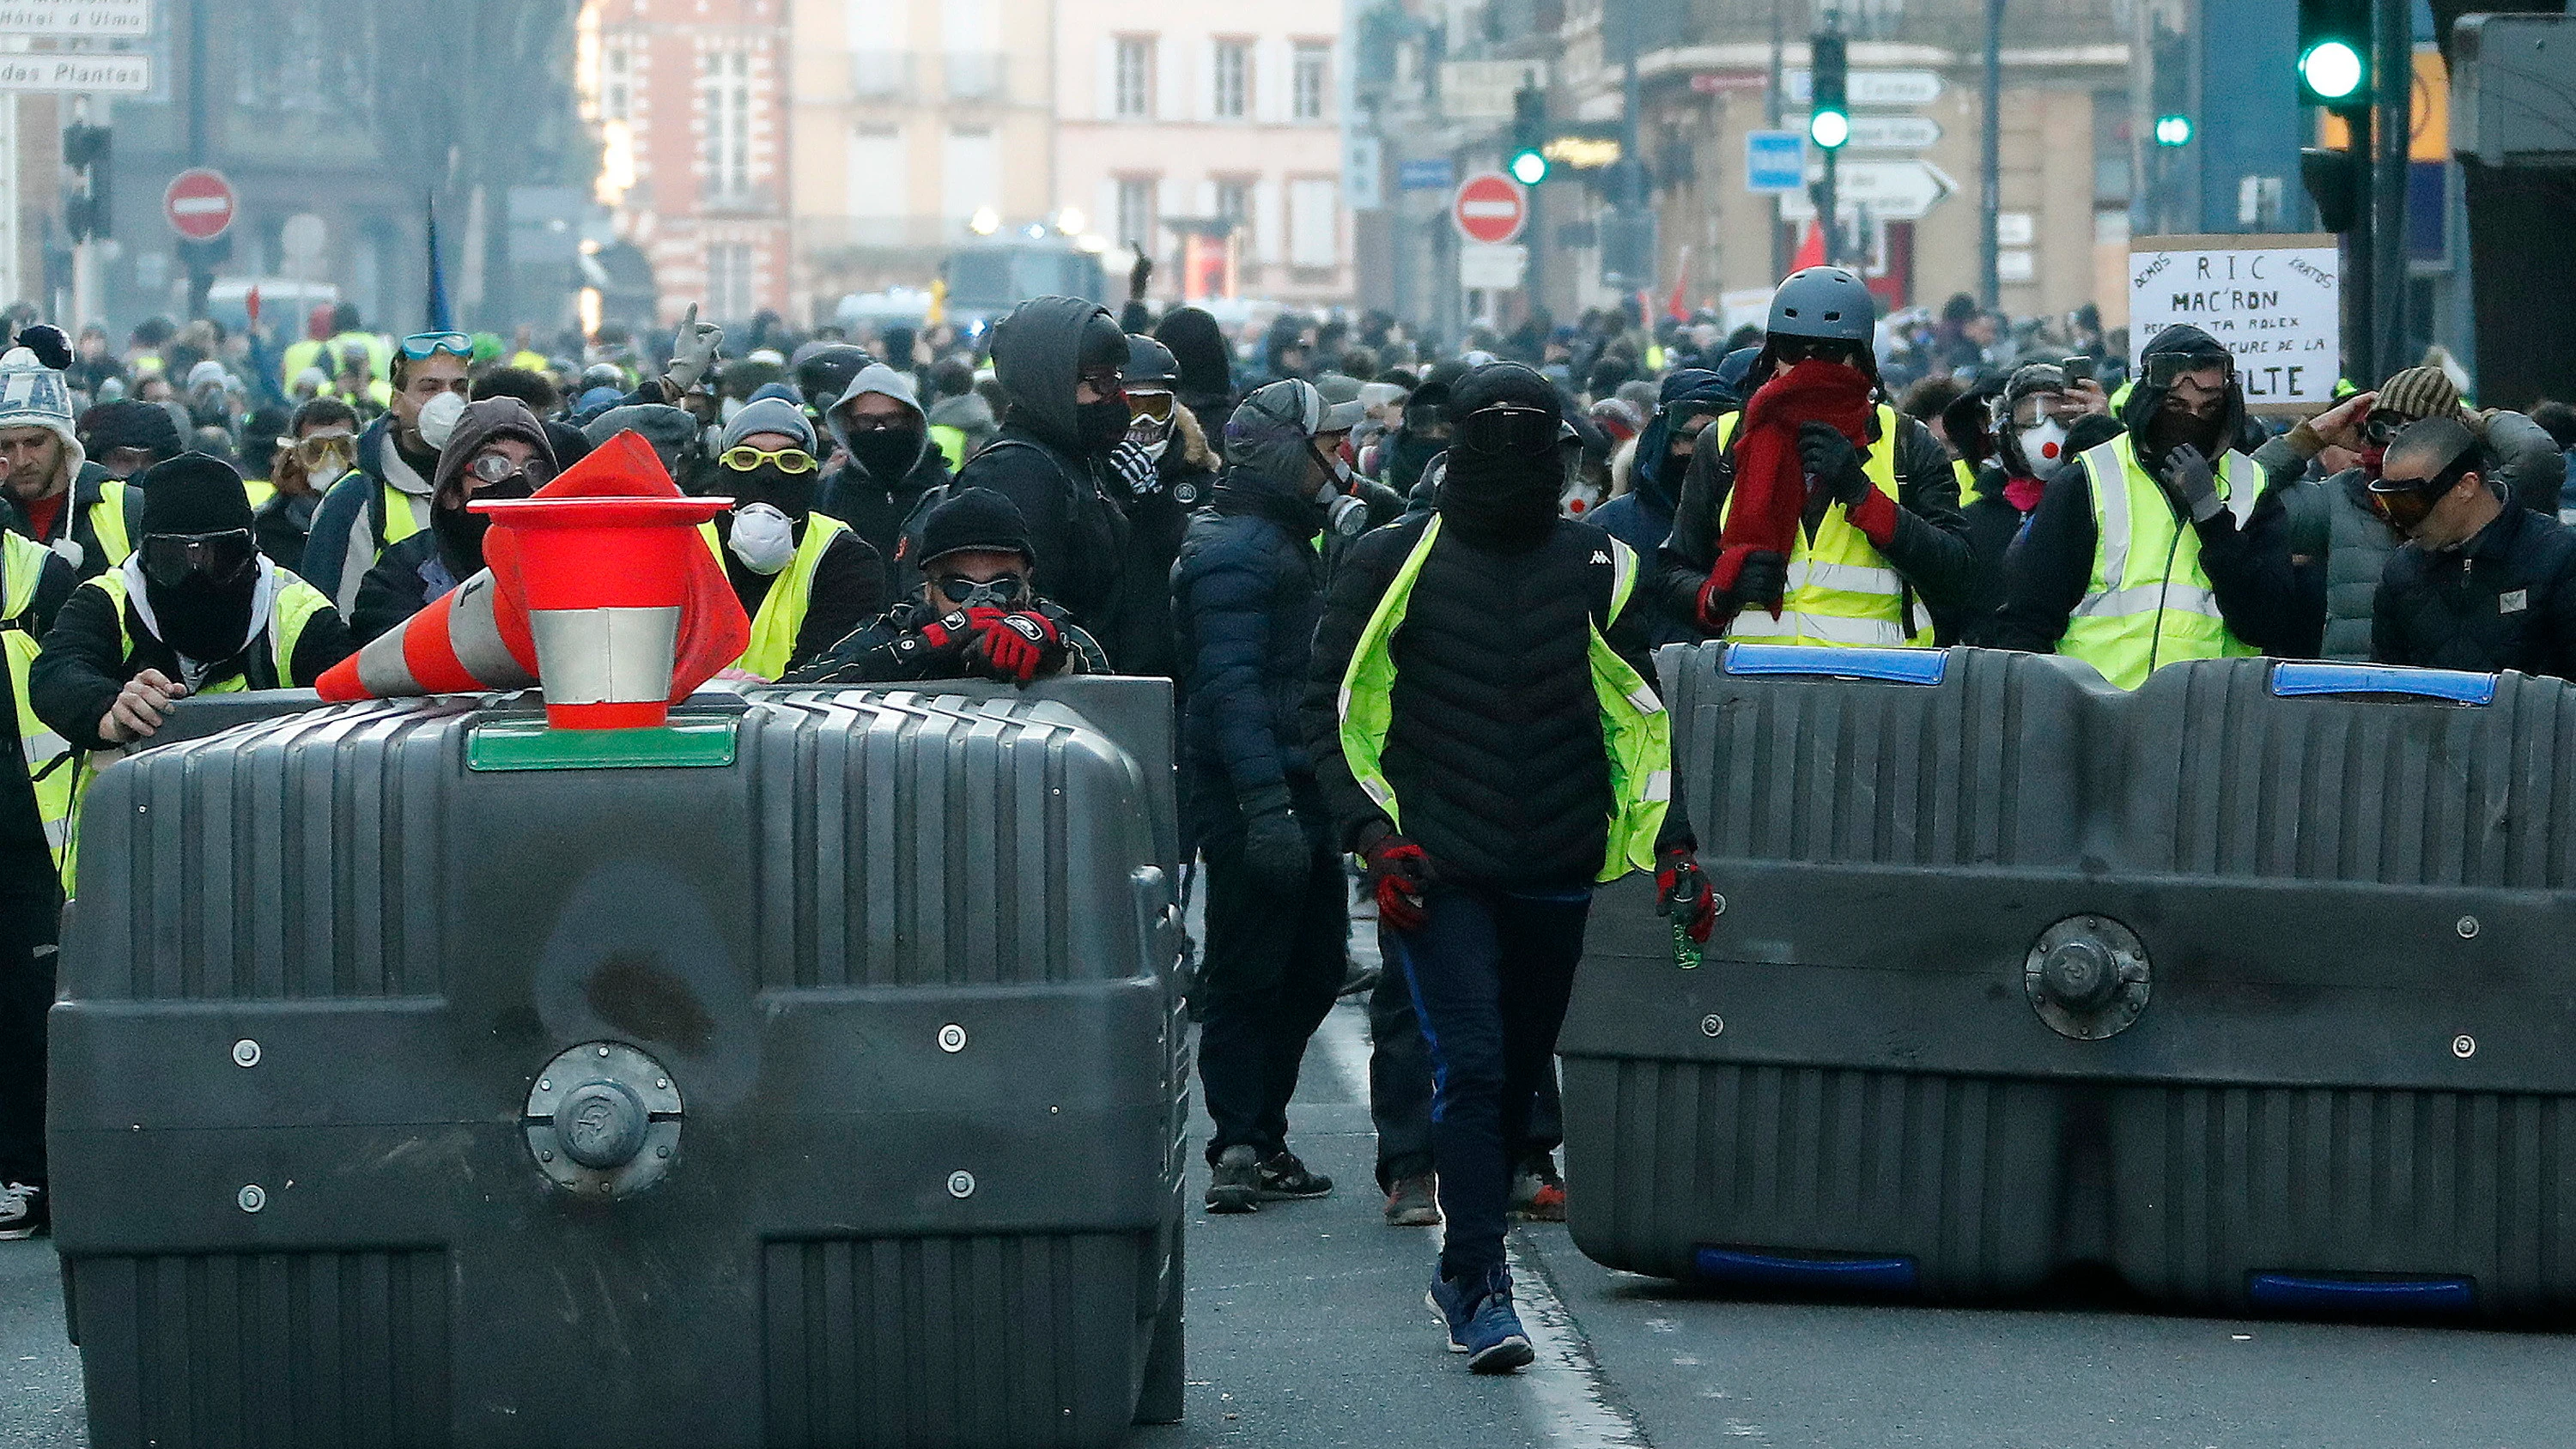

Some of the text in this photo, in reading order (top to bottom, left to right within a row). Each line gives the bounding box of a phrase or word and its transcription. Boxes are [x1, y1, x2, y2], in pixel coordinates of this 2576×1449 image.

[54, 62, 140, 82] Plantes
[2133, 252, 2172, 288] DEMOS
[2287, 257, 2336, 288] KRATOS
[2210, 319, 2234, 331] TA
[2248, 317, 2300, 330] ROLEX
[2275, 338, 2294, 353] DE
[2304, 337, 2325, 351] LA
